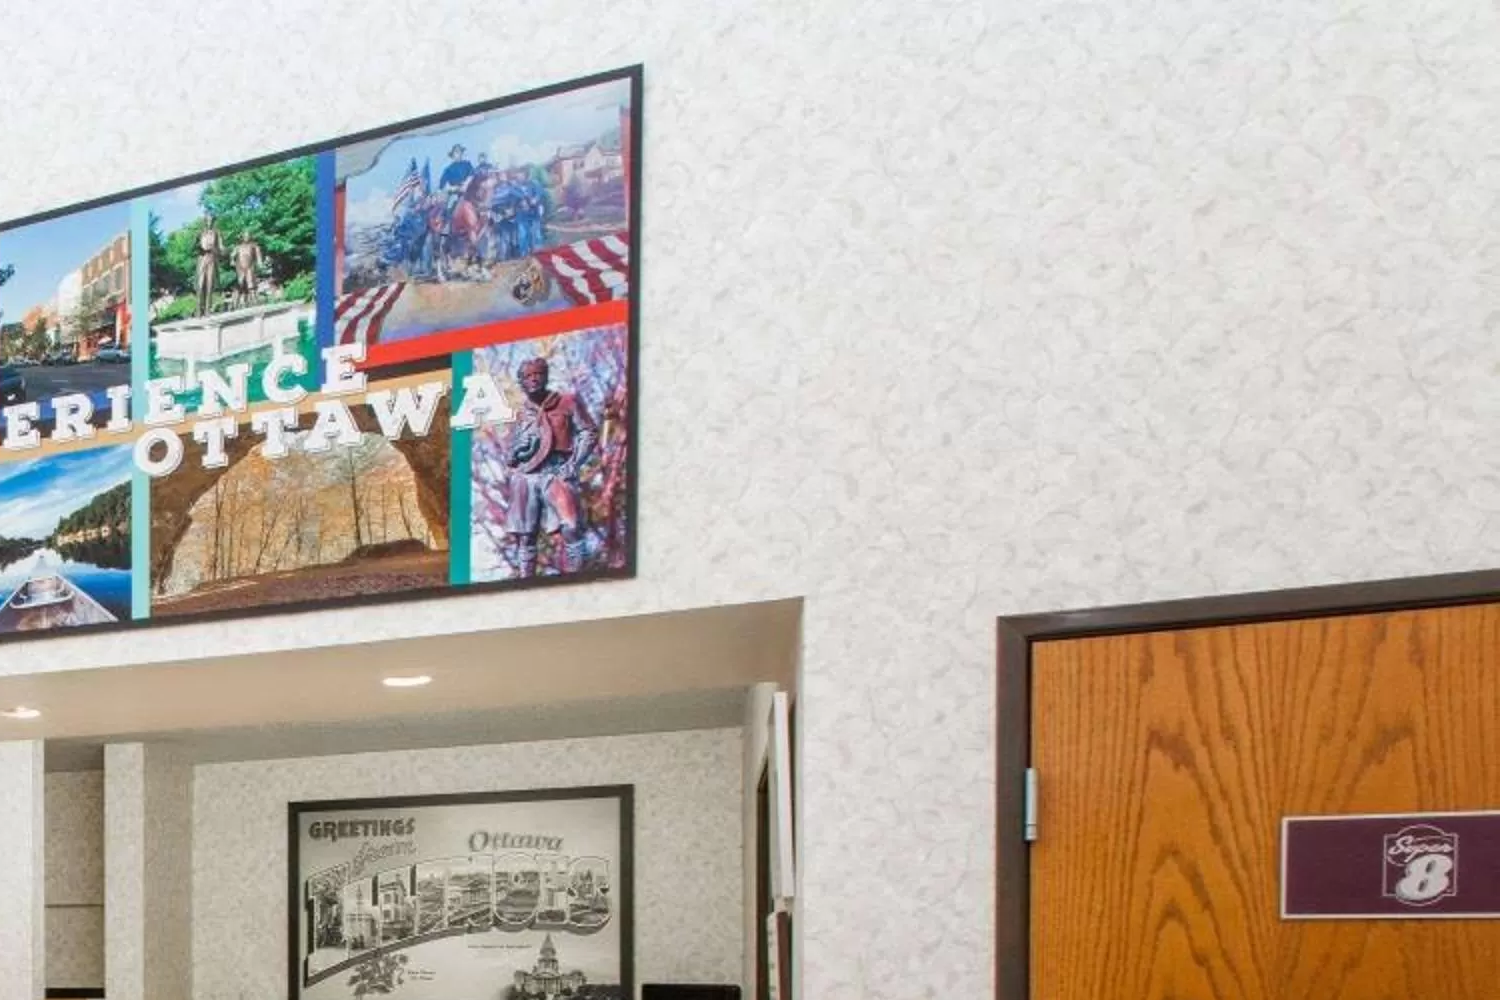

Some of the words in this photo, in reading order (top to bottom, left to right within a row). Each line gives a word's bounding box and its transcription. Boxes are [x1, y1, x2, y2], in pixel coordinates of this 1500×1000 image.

[134, 372, 517, 478] OTTAWA
[308, 816, 417, 842] GREETINGS
[467, 830, 564, 852] Ottawa
[1387, 835, 1454, 864] Super
[1395, 853, 1453, 901] 8
[303, 851, 612, 988] ILLINOIS
